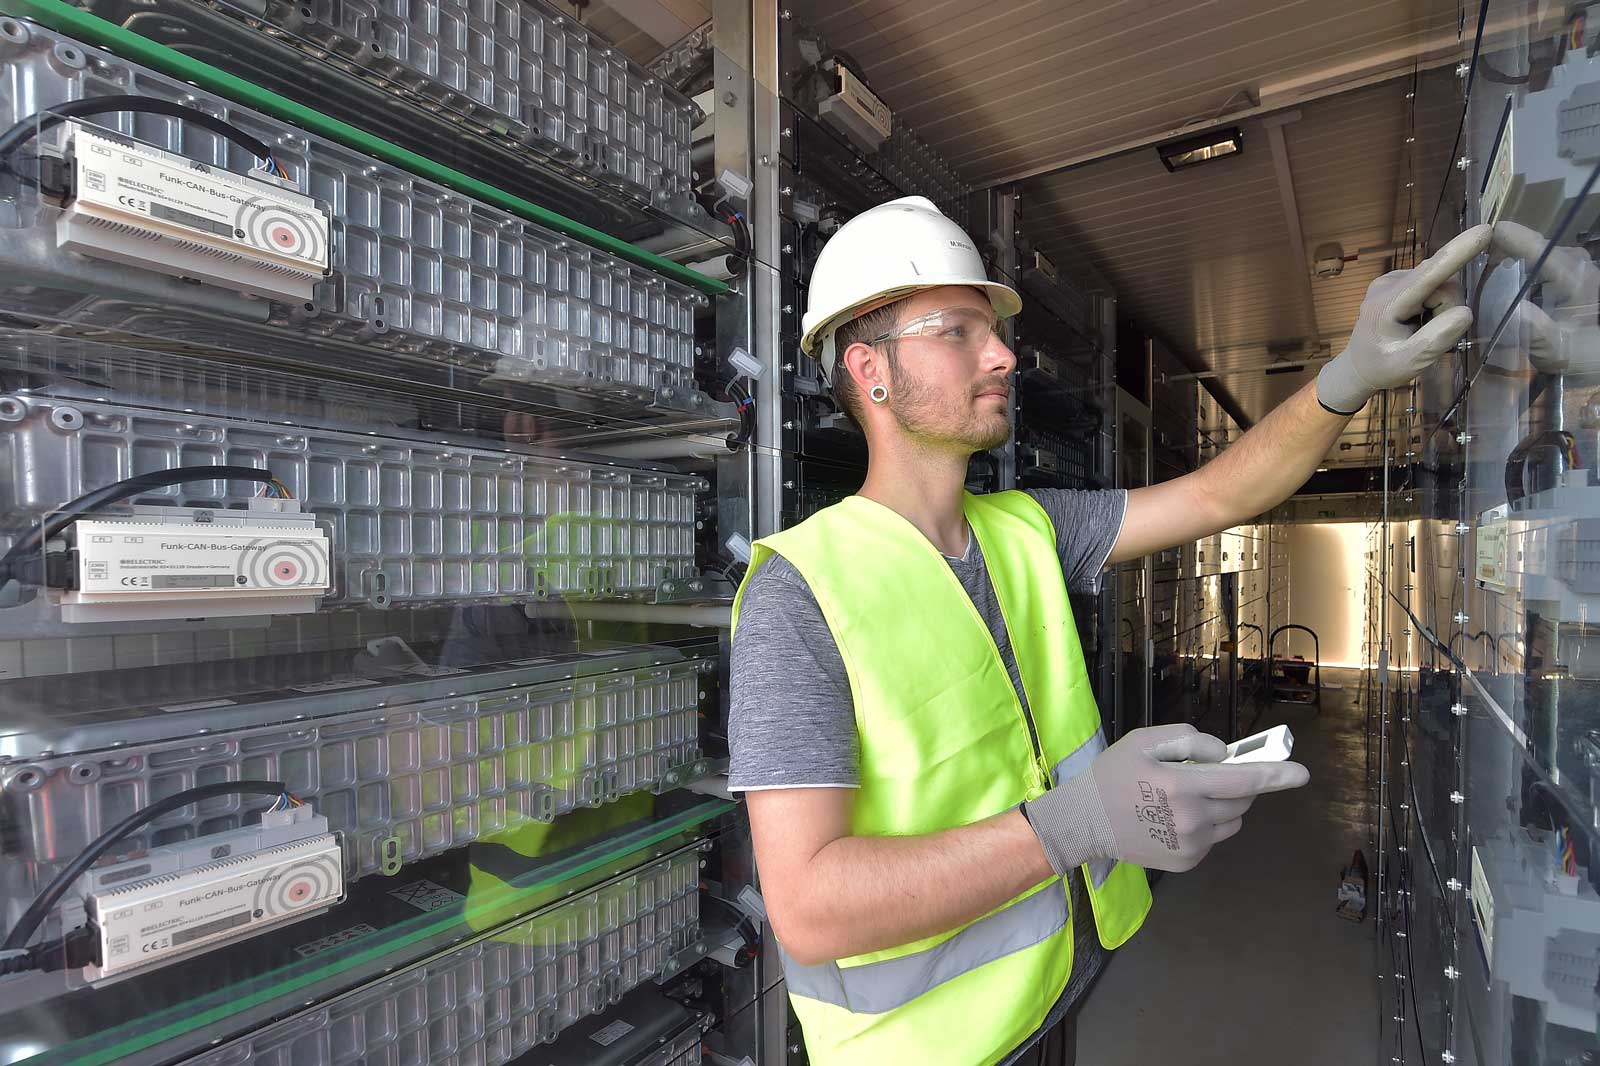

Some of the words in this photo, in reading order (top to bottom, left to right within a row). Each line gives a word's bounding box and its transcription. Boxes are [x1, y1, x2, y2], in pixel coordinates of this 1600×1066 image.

[159, 172, 267, 213] Funk-CAN-Bus-Gateway
[160, 542, 268, 552] Funk-CAN-Bus-Gateway
[179, 873, 283, 908] Funk-CAN-Bus-Gateway
